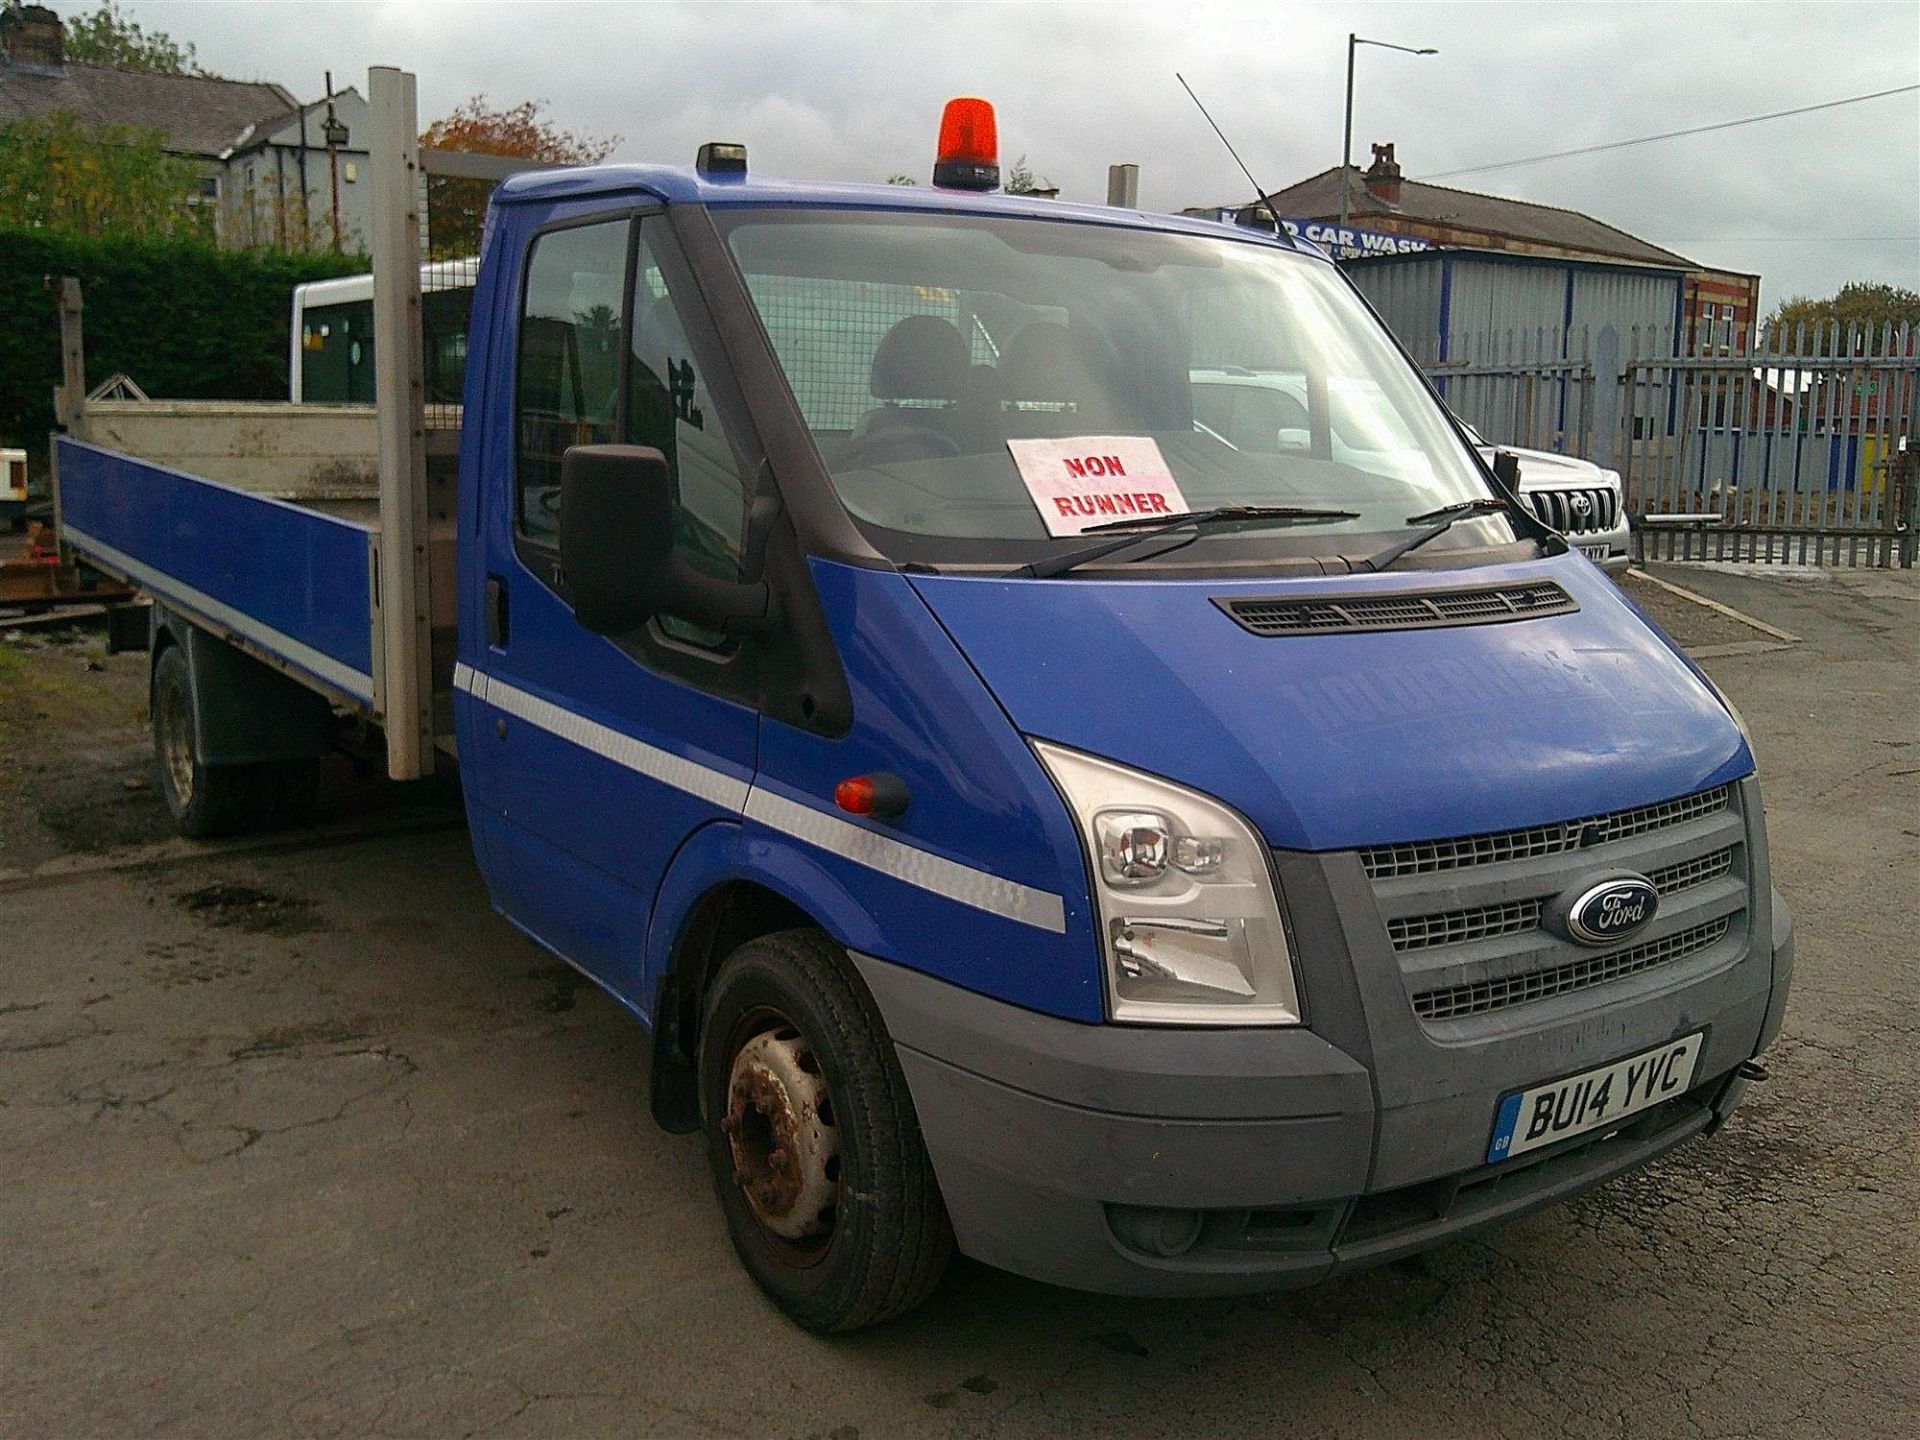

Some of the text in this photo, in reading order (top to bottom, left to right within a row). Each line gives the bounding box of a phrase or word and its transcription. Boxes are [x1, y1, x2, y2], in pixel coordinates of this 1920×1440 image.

[1221, 211, 1426, 256] HD CAR WASH
[1063, 455, 1127, 479] NON
[1052, 492, 1173, 518] RUNNER
[1598, 890, 1645, 929] Ford
[1525, 1046, 1687, 1141] BU14 YVC
[1495, 1135, 1510, 1151] GB
